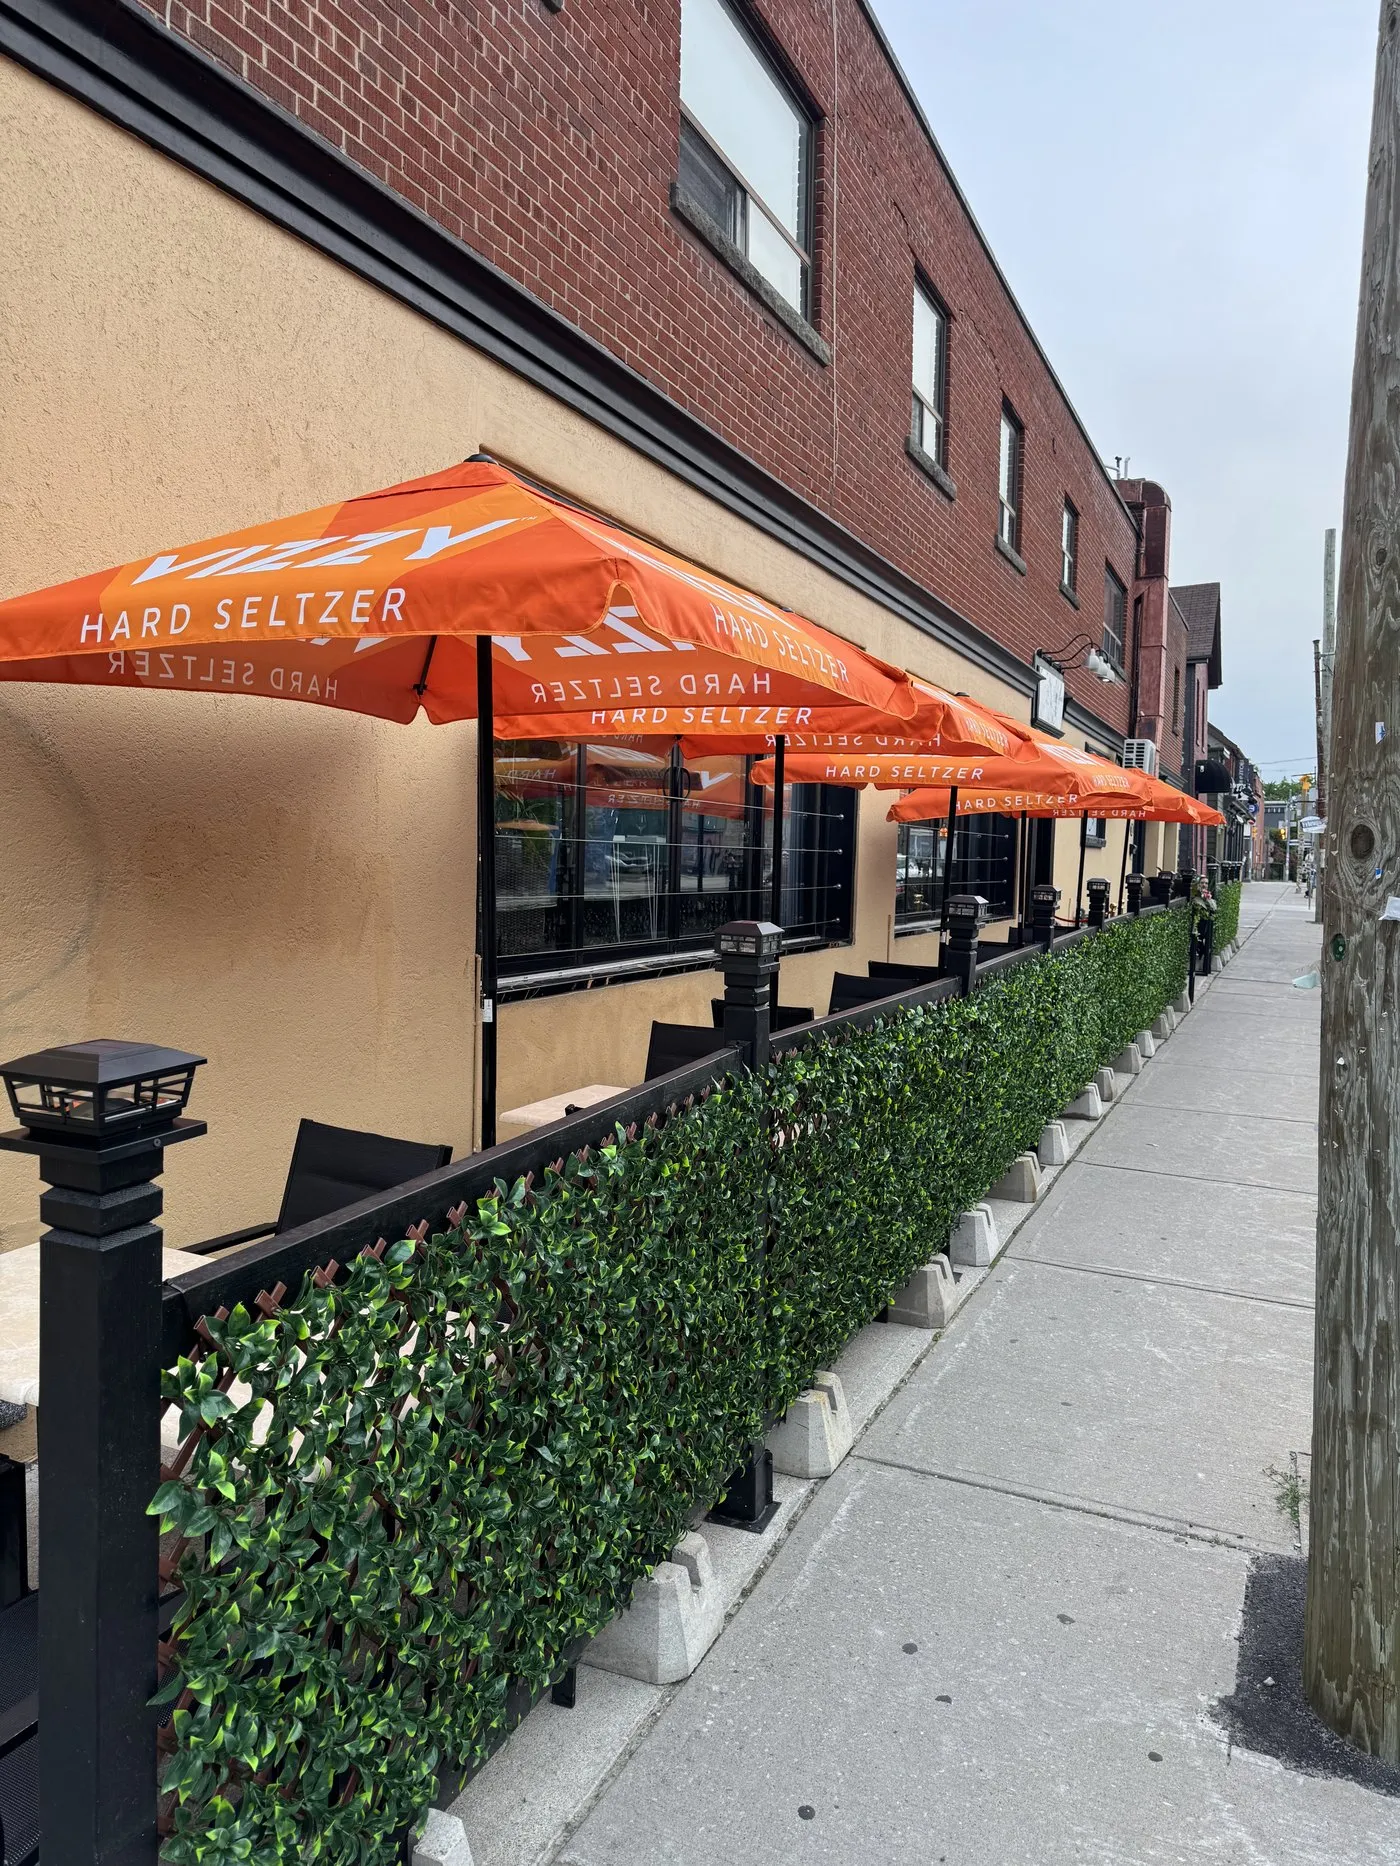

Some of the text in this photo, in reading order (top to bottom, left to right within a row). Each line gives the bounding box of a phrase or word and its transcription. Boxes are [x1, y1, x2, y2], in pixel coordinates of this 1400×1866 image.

[131, 518, 520, 586] VIZZY
[80, 588, 406, 644] HARD SELTZER
[709, 602, 769, 649] HARD
[772, 630, 850, 683] SELTZER
[591, 707, 811, 725] HARD SELTZER
[826, 766, 984, 780] HARD SELTZER
[1004, 794, 1078, 806] SELTZER
